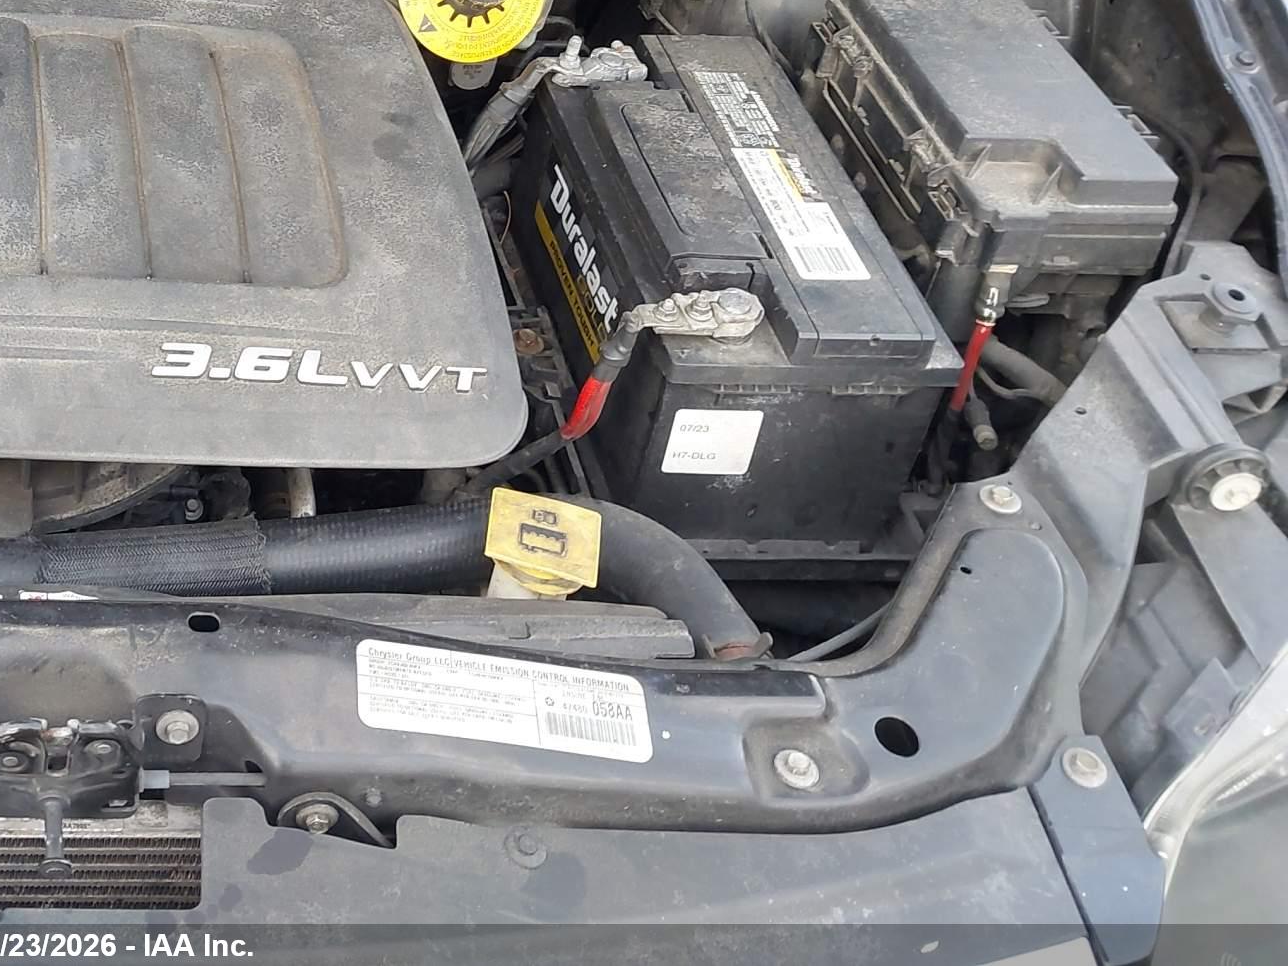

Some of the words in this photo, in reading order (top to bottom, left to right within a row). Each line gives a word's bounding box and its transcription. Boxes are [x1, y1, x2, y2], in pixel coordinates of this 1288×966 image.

[550, 163, 618, 333] Duralast
[680, 424, 710, 433] 07/23
[368, 647, 402, 659] Chrysler
[406, 652, 431, 665] Group
[454, 660, 487, 671] VEHICLE
[490, 665, 530, 678] EMISSION
[532, 670, 569, 683] CONTROL
[572, 677, 630, 692] INFORMATION
